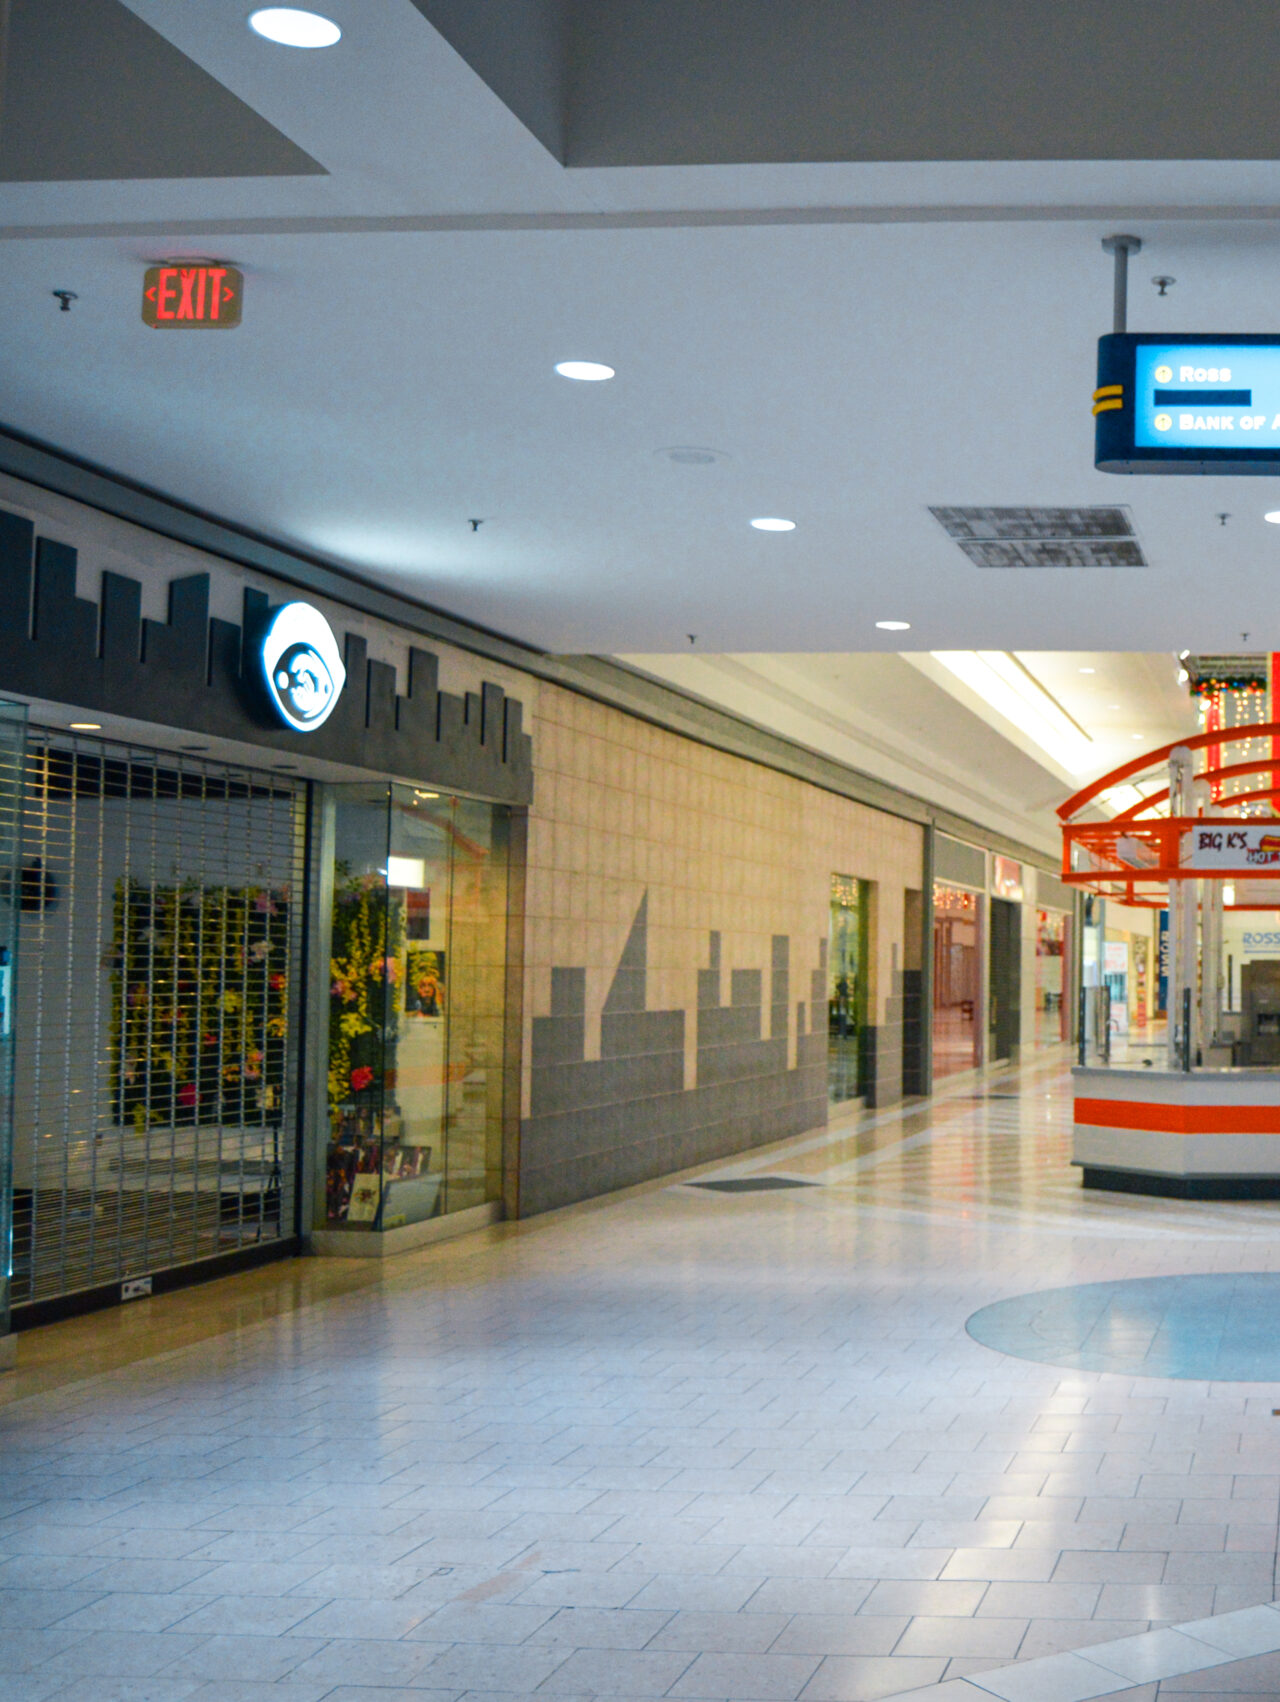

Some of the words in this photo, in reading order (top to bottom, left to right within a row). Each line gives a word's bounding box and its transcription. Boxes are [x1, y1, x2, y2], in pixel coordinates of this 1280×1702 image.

[157, 268, 227, 320] EXIT
[1180, 366, 1232, 382] ROSS
[1179, 414, 1234, 430] BANK
[1239, 415, 1266, 430] OF
[1198, 832, 1223, 851] BIG
